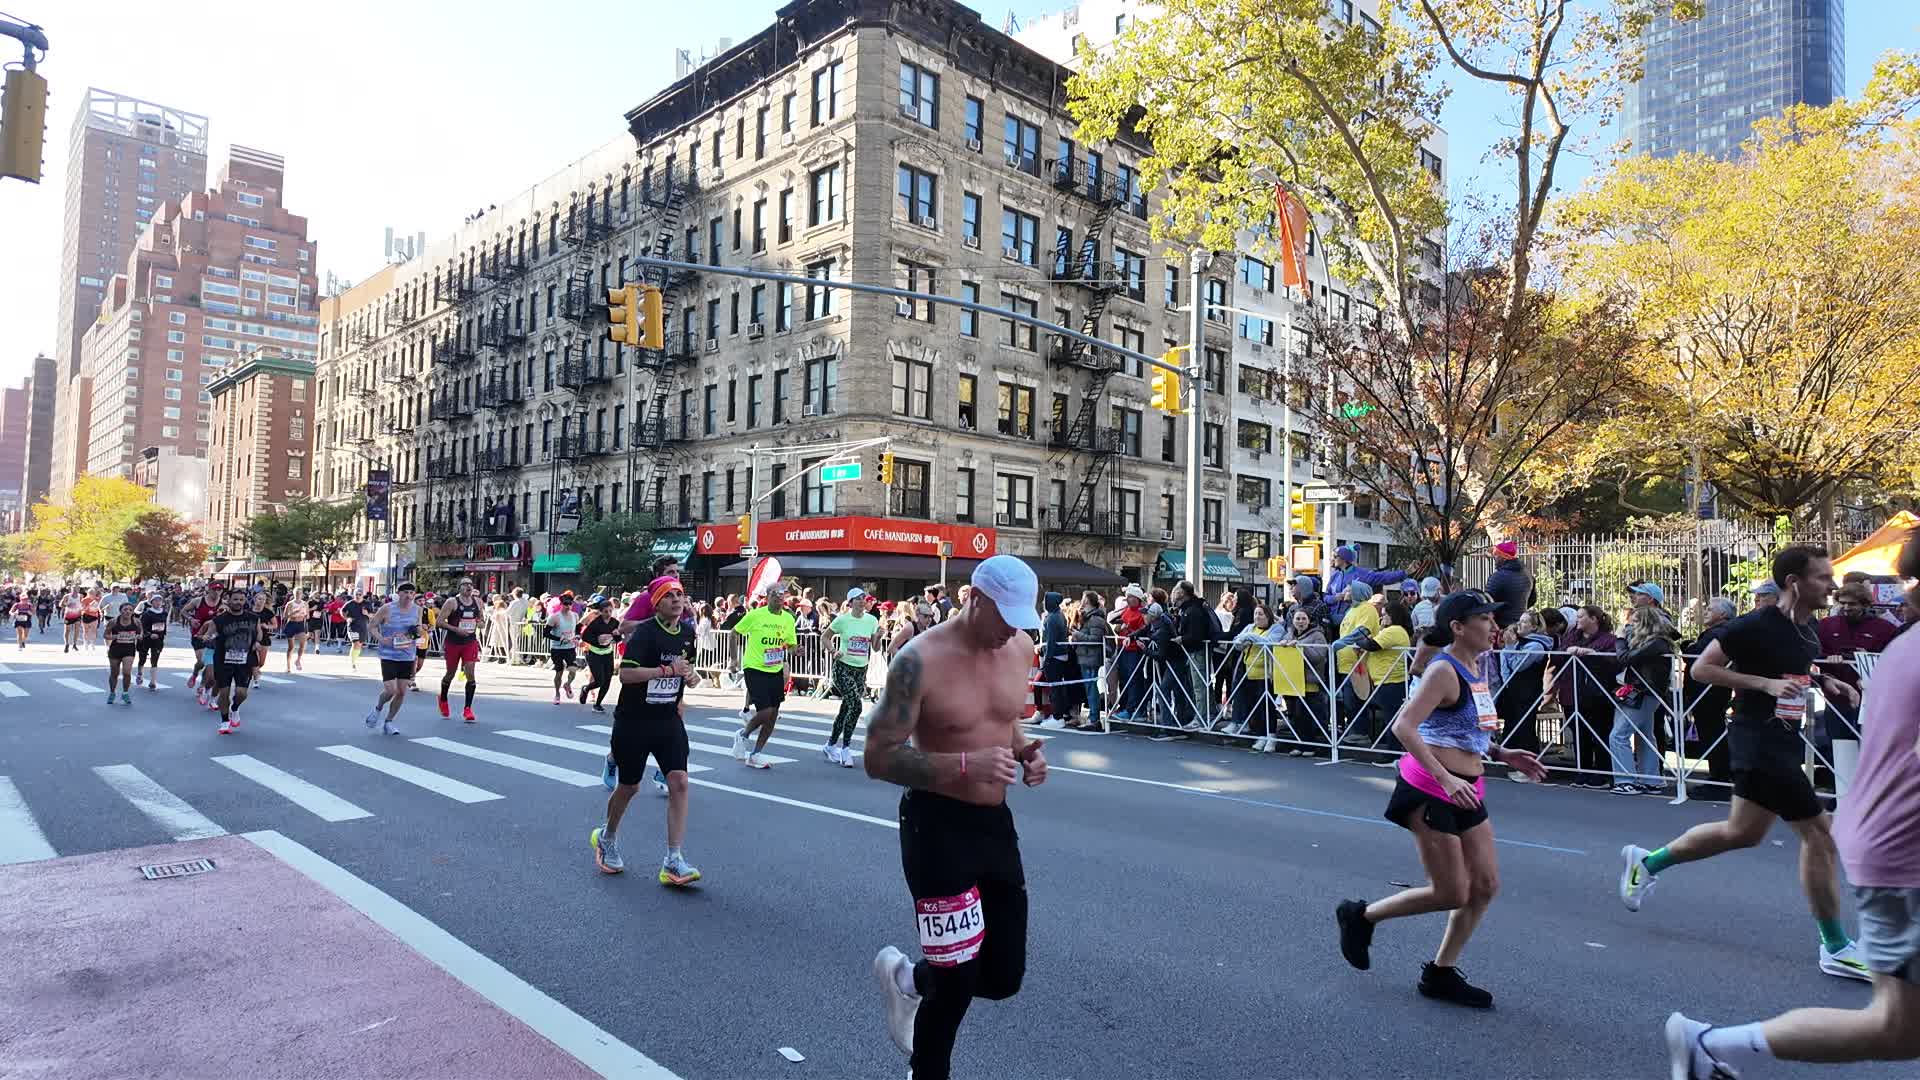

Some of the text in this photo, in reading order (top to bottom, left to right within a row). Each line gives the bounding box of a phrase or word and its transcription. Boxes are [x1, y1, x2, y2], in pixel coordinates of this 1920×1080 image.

[864, 528, 884, 541] CAFÉ
[884, 531, 923, 544] MANDARIN
[654, 678, 679, 690] 7058
[923, 905, 980, 937] 15445
